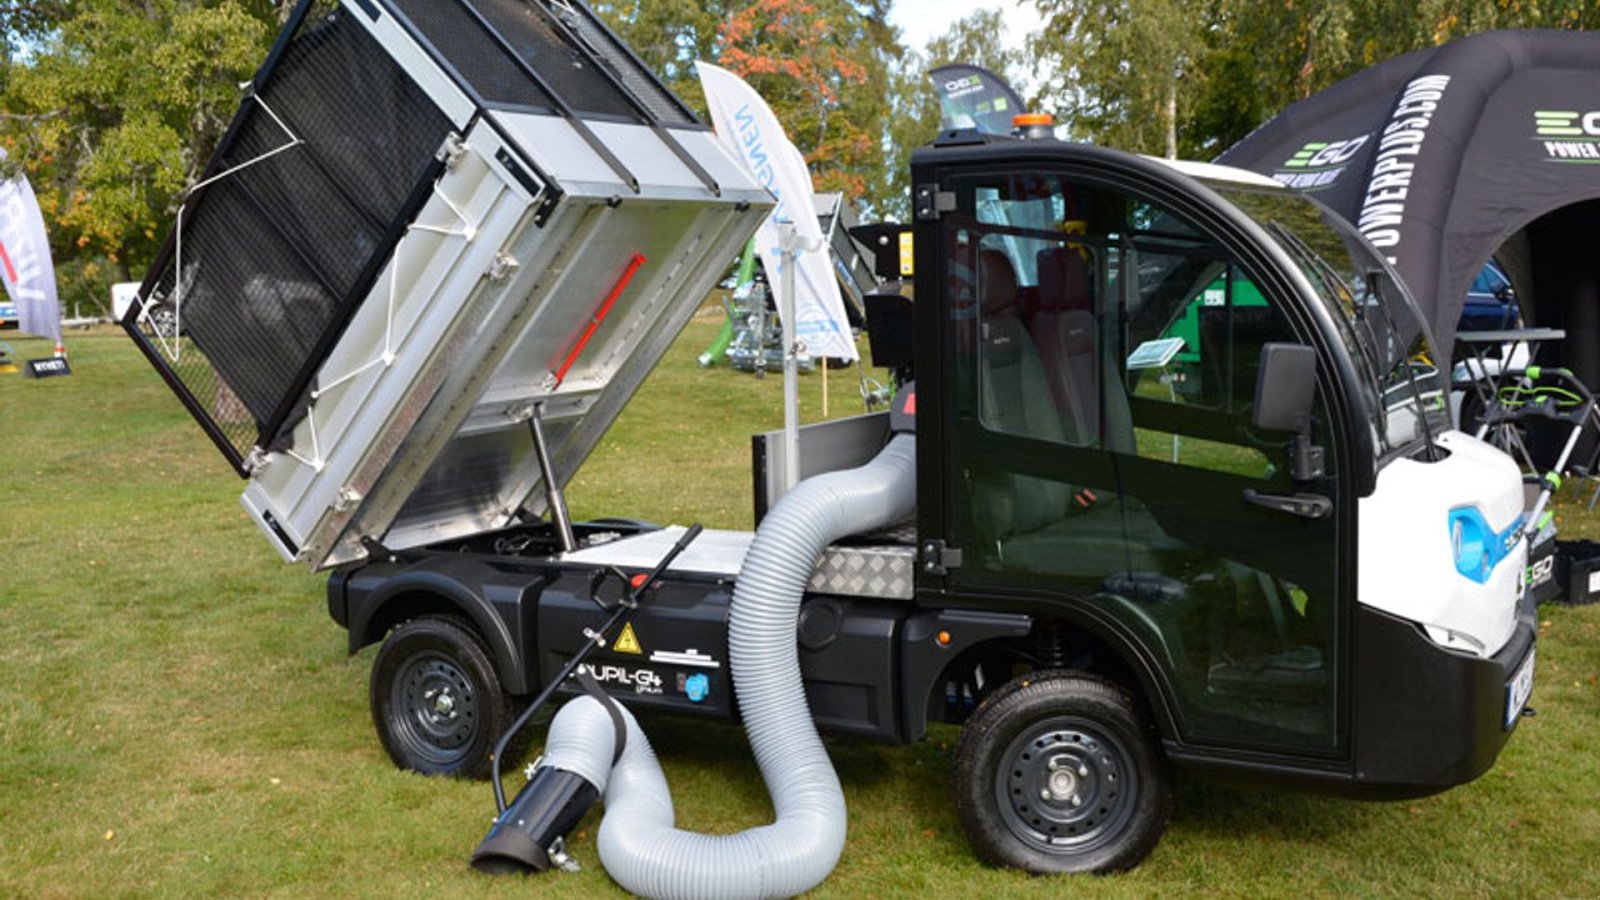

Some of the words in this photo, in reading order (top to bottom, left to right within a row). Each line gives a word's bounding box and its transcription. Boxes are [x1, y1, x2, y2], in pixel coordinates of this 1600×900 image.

[1284, 135, 1370, 166] EGO
[1358, 75, 1450, 264] OWERPLUS.COM
[562, 662, 662, 686] UPIL-G4
